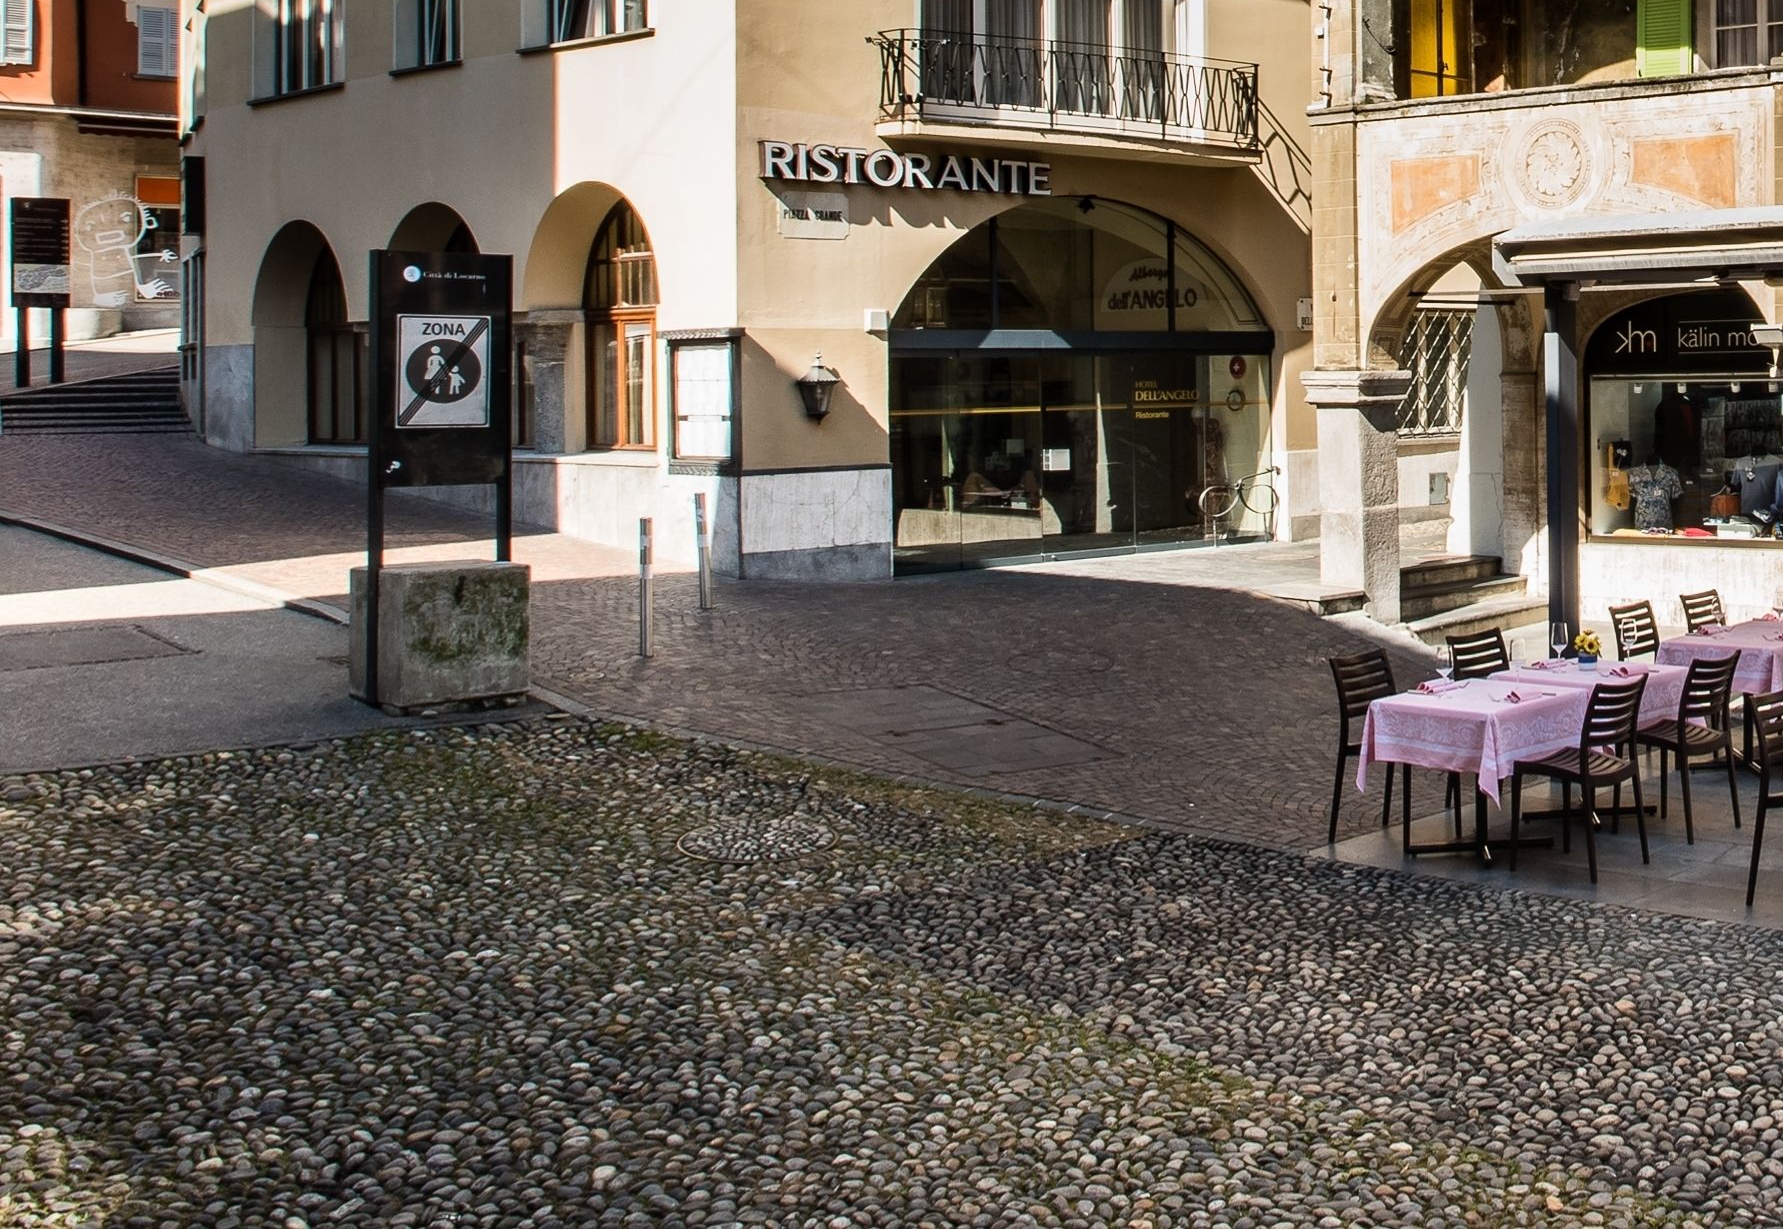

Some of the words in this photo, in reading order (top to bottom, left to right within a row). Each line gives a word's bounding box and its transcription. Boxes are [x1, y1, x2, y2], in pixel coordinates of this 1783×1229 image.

[757, 140, 1052, 196] RISTORANTE
[783, 209, 810, 221] PIAZZA
[815, 210, 843, 222] GRANDE
[422, 322, 466, 336] ZONA
[1677, 327, 1720, 348] kälin
[1135, 380, 1158, 388] HOTEL
[1135, 390, 1200, 401] DELL'ANGELO
[1135, 411, 1169, 419] Ristorante
